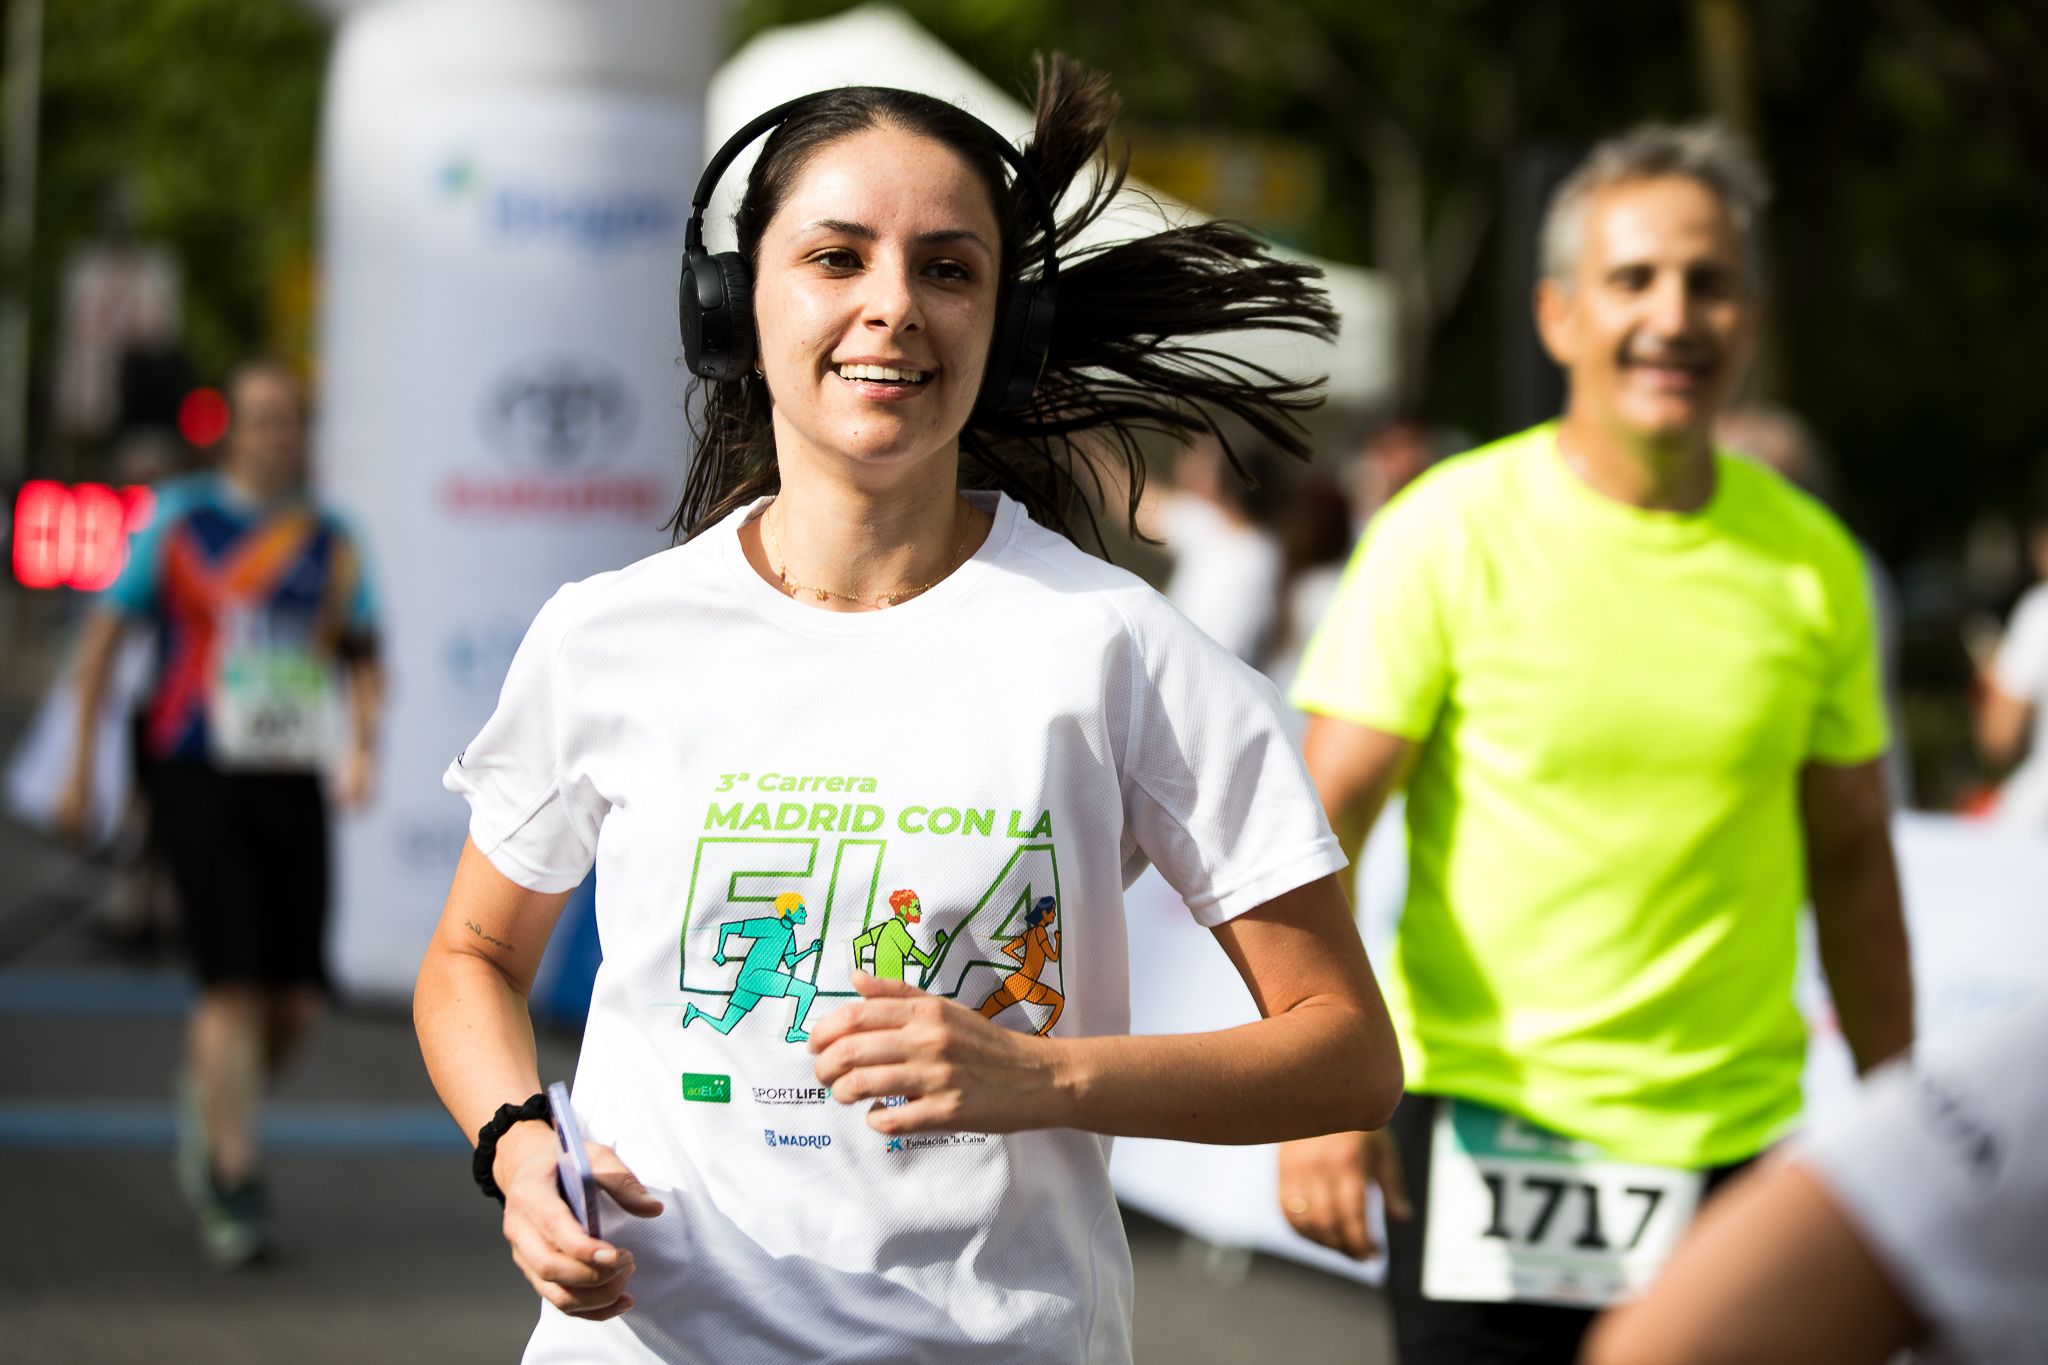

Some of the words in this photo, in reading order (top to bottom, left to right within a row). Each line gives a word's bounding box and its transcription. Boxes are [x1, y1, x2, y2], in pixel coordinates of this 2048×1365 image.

[756, 772, 878, 794] Carrera
[703, 802, 886, 833] MADRID
[897, 805, 996, 837] CON
[1006, 809, 1053, 839] LA
[680, 837, 1067, 1000] ELA
[778, 1135, 832, 1149] MADRID
[906, 1135, 949, 1149] Fundación
[1481, 1171, 1665, 1250] 1717
